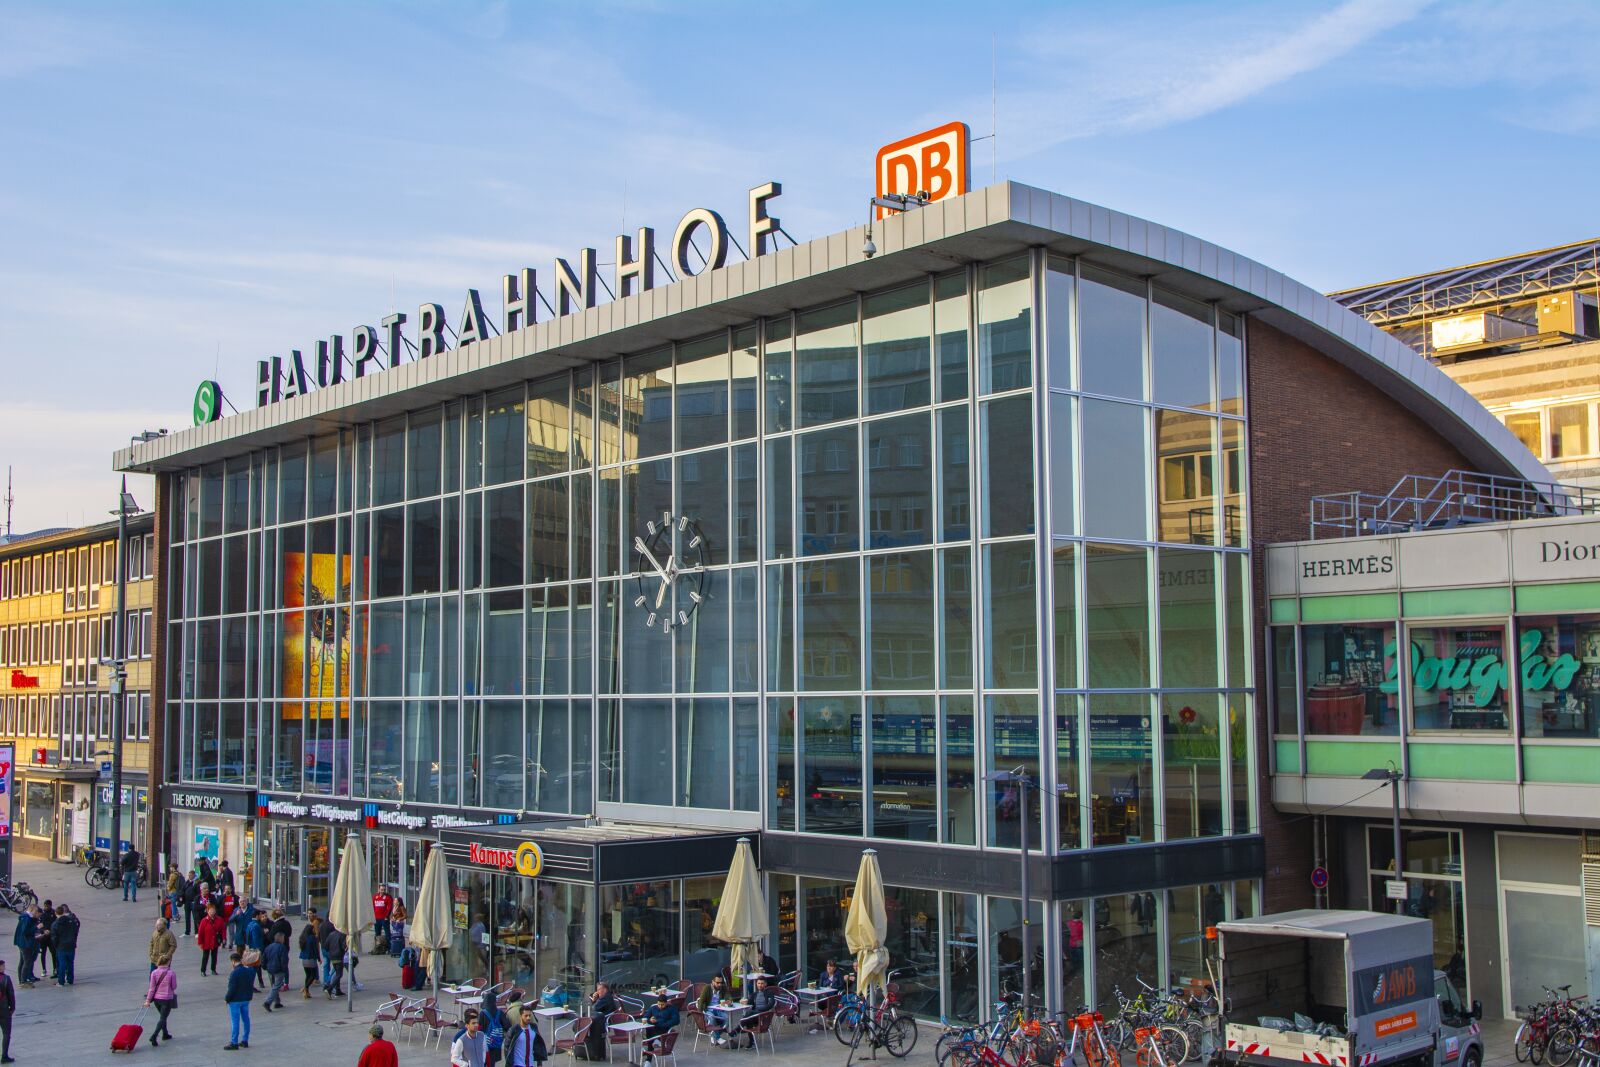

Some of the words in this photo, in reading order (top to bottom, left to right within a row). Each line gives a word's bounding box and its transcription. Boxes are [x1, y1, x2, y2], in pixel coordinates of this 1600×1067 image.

[887, 141, 952, 215] DB
[256, 182, 782, 407] HAUPTBAHNHOF
[196, 386, 211, 426] S
[1540, 540, 1600, 563] Dior
[1379, 630, 1580, 707] Douglas
[172, 793, 184, 806] THE
[185, 794, 203, 808] BODY
[203, 796, 221, 810] SHOP
[268, 801, 307, 818] NetCologne
[322, 804, 361, 823] Highspeed
[378, 810, 425, 830] NetCologne
[470, 842, 514, 871] Kamps
[1387, 967, 1416, 1002] AWB
